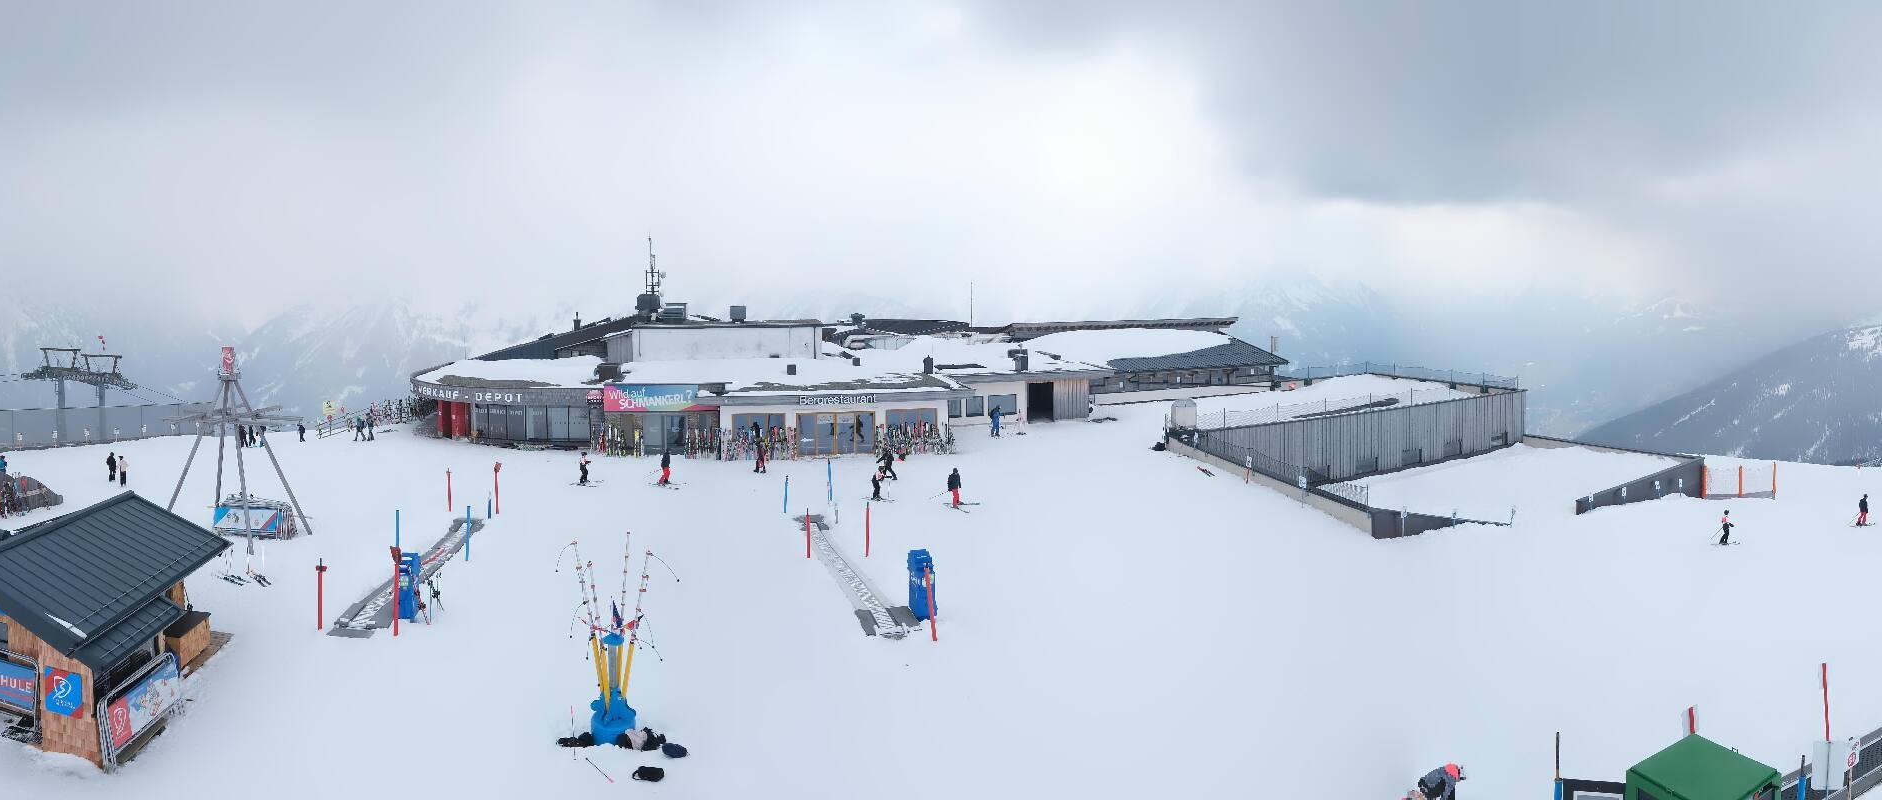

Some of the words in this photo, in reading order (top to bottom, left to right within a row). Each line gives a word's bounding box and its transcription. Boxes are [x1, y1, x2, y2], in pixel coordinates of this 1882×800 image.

[418, 385, 459, 400] VERKAUF
[475, 392, 523, 403] DEPOT
[608, 388, 629, 400] Wild
[630, 387, 646, 398] auf
[618, 389, 693, 410] SCHMANKERL?
[799, 393, 876, 406] Bergrestaurant
